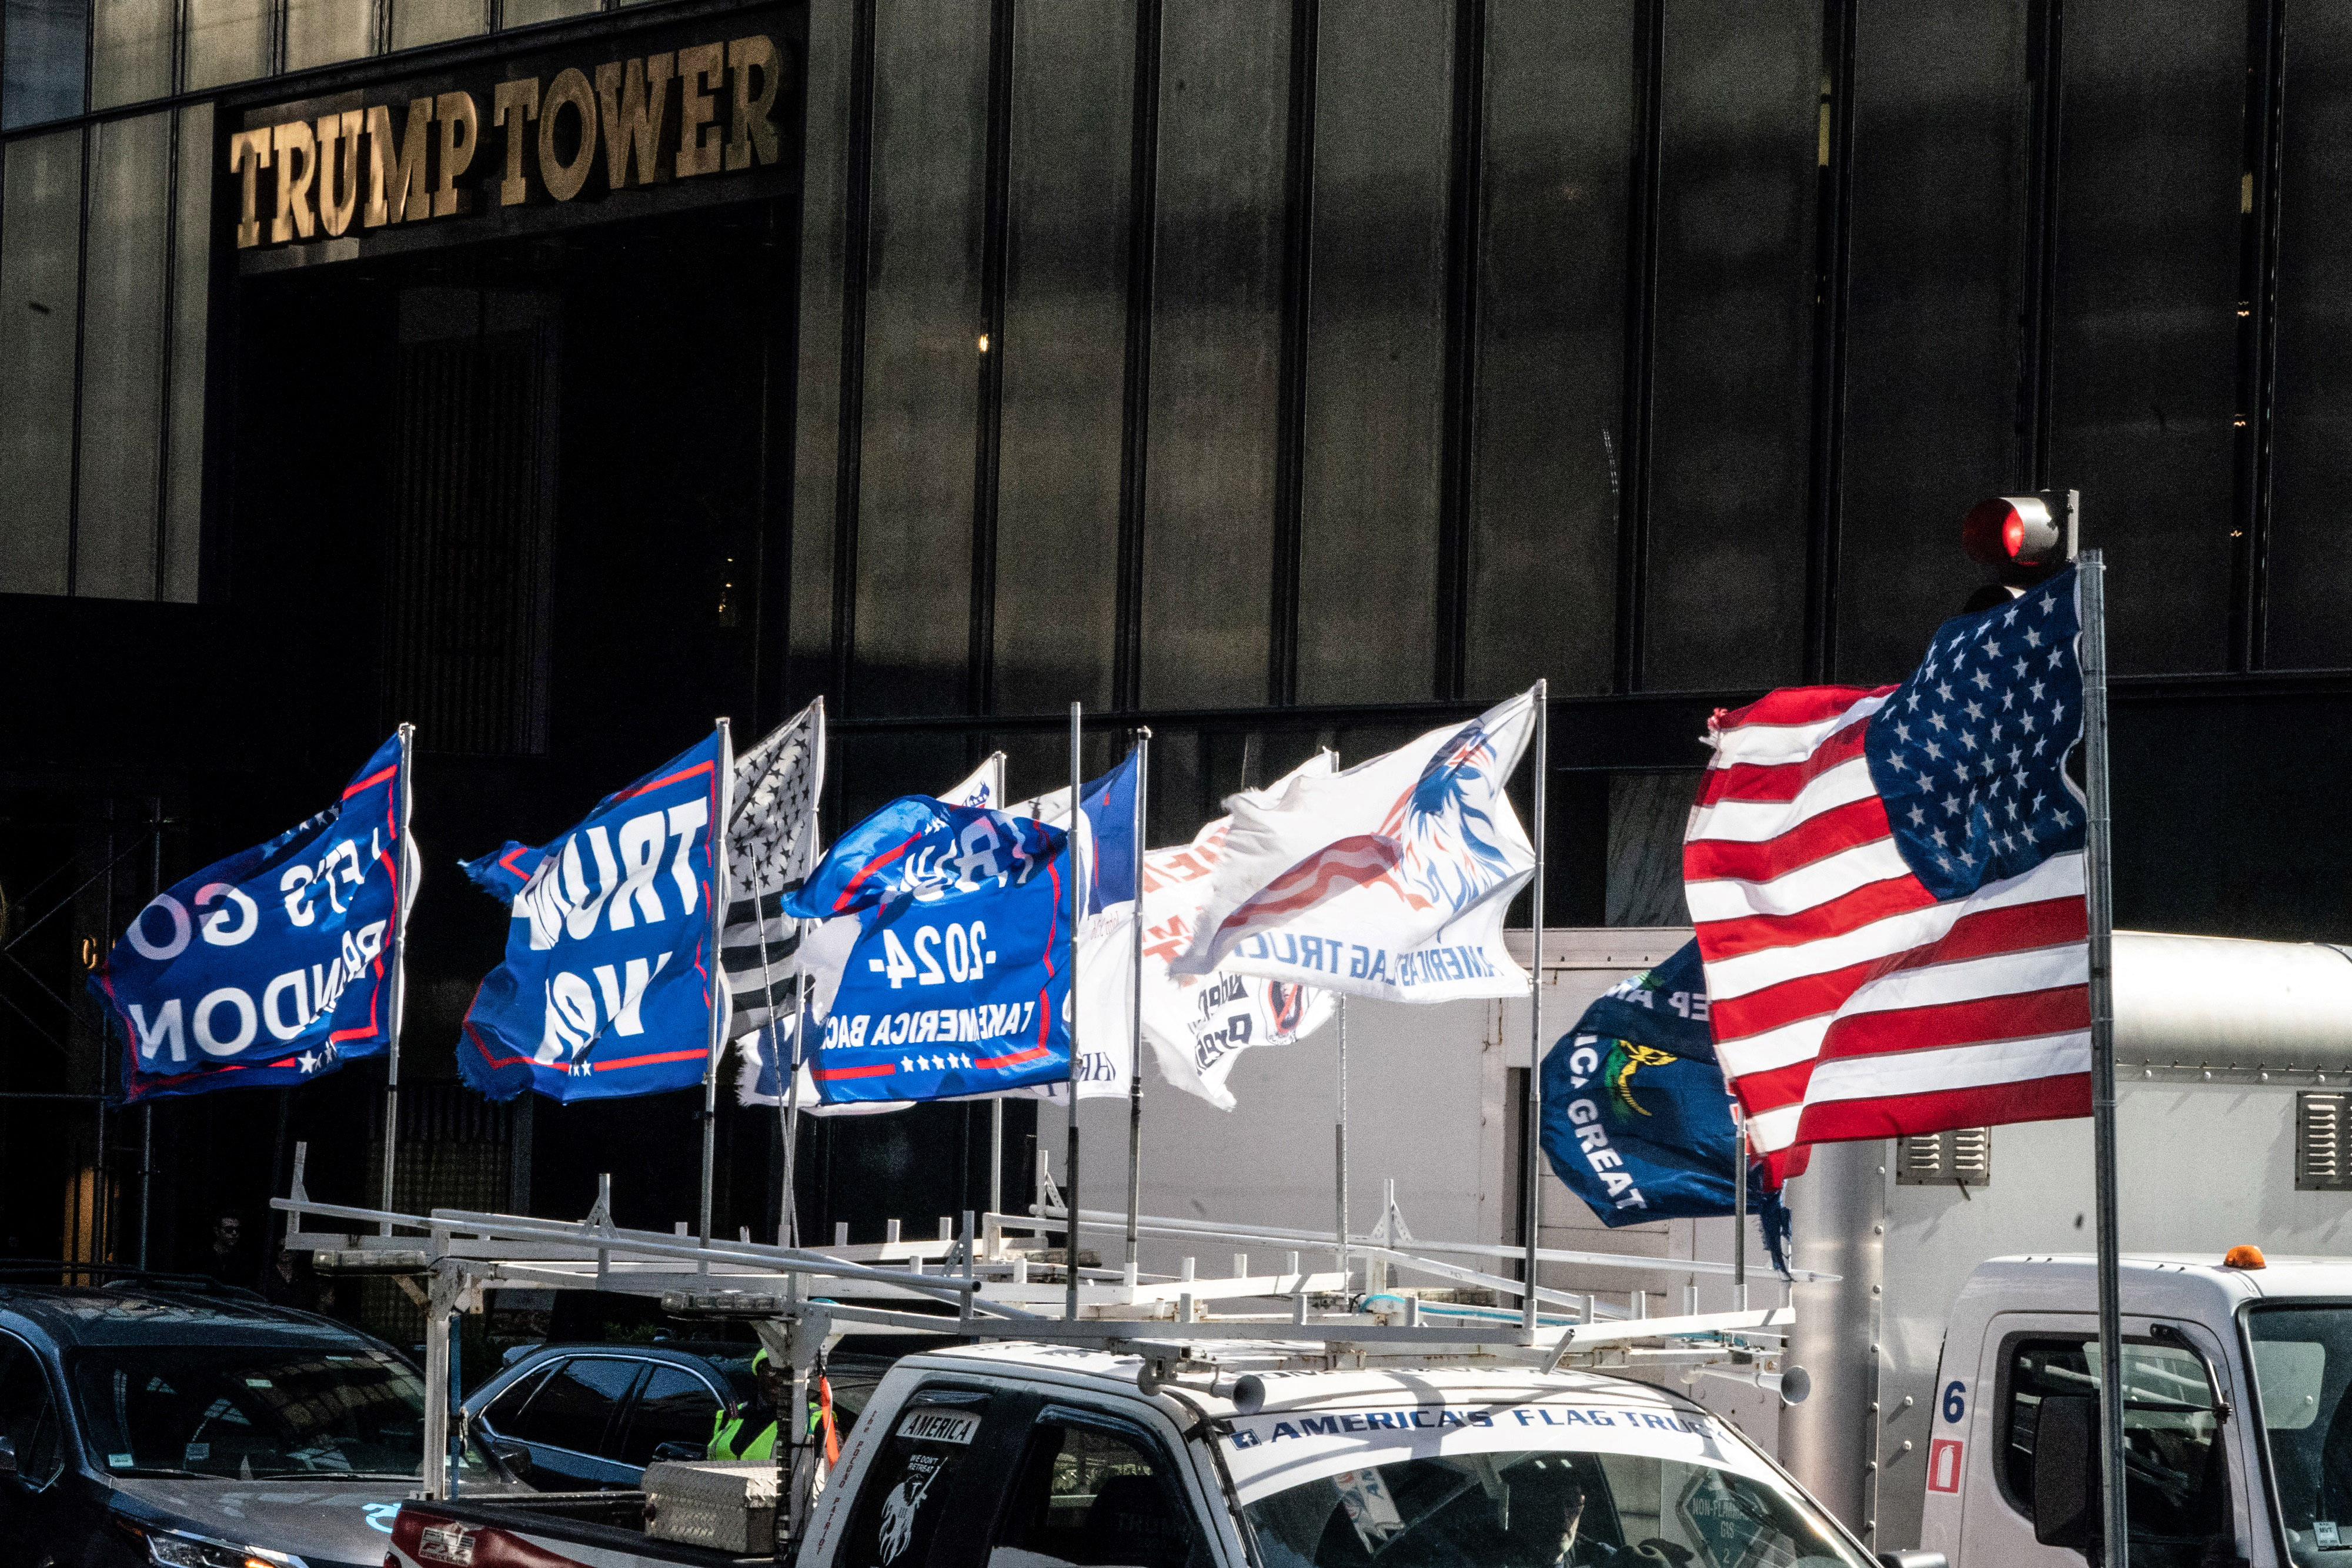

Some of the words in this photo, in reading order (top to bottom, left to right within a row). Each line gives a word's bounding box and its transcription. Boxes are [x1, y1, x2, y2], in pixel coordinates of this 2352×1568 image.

[230, 91, 477, 249] TRUMP
[494, 34, 781, 206] TOWER
[1568, 1099, 1647, 1209] GREAT
[1943, 1380, 1966, 1423] 6
[904, 1415, 972, 1441] AMERICA
[1271, 1410, 1494, 1443] AMERICA'S
[1518, 1409, 1614, 1427] FLAG
[1723, 1547, 1730, 1564] 2
